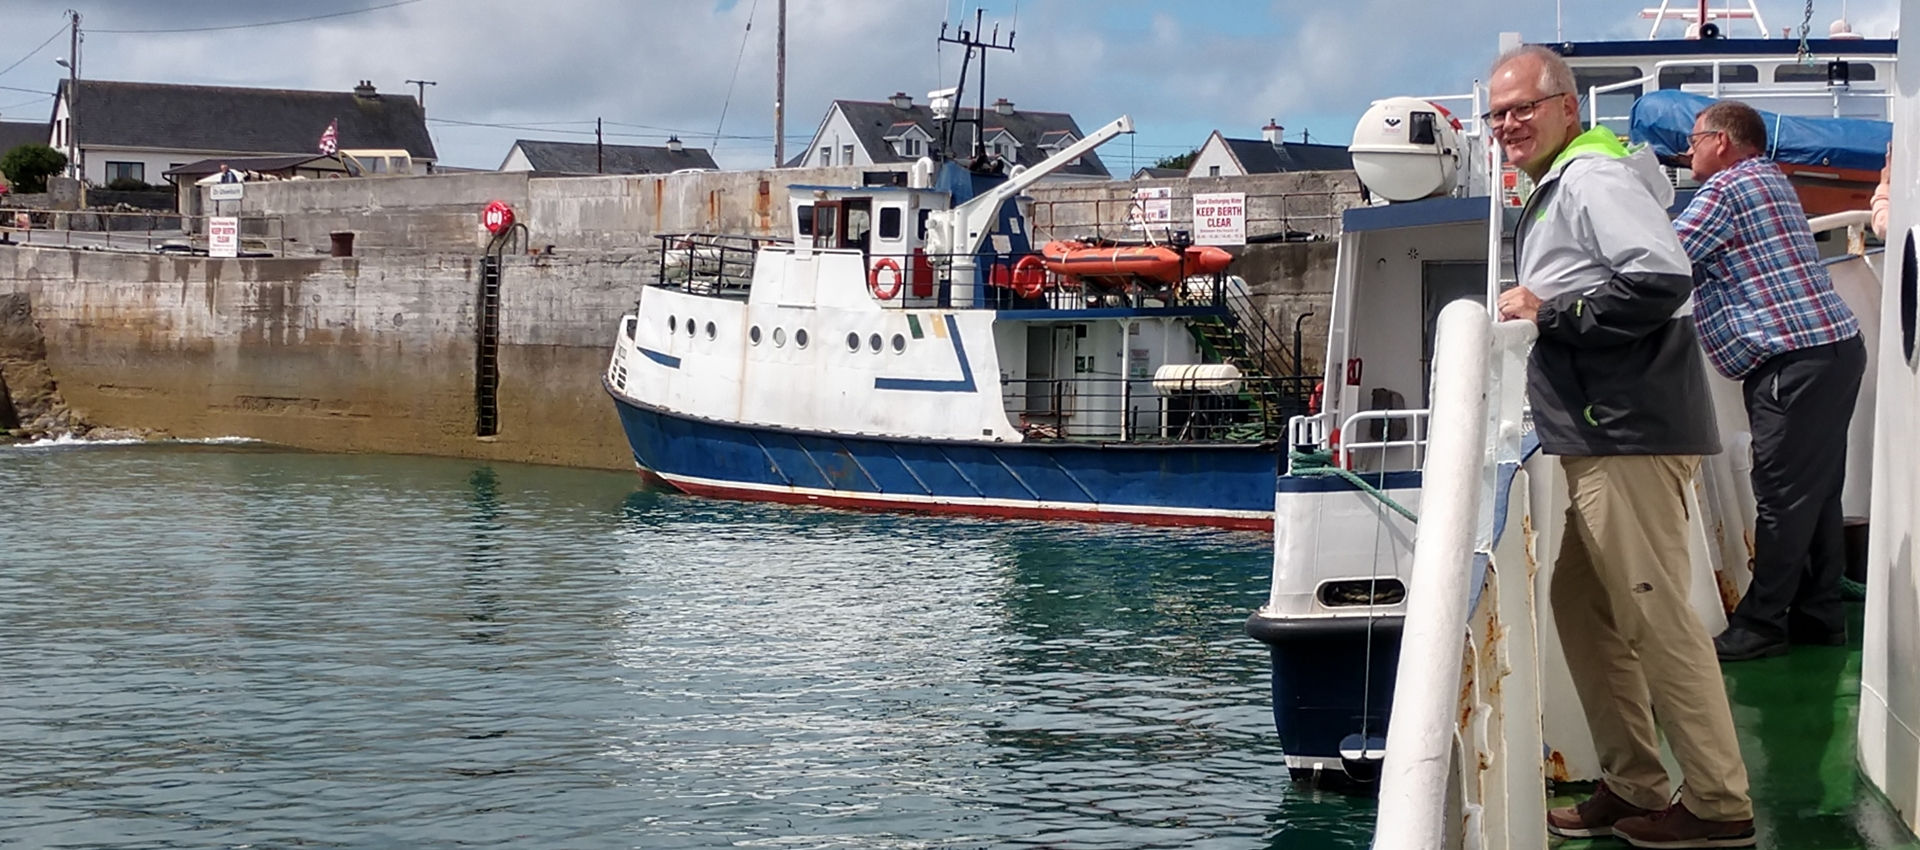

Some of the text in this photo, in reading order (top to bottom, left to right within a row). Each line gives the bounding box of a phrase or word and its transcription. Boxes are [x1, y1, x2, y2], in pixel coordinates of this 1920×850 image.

[1196, 206, 1242, 216] KEEP BERTH
[1207, 218, 1231, 227] CLEAR
